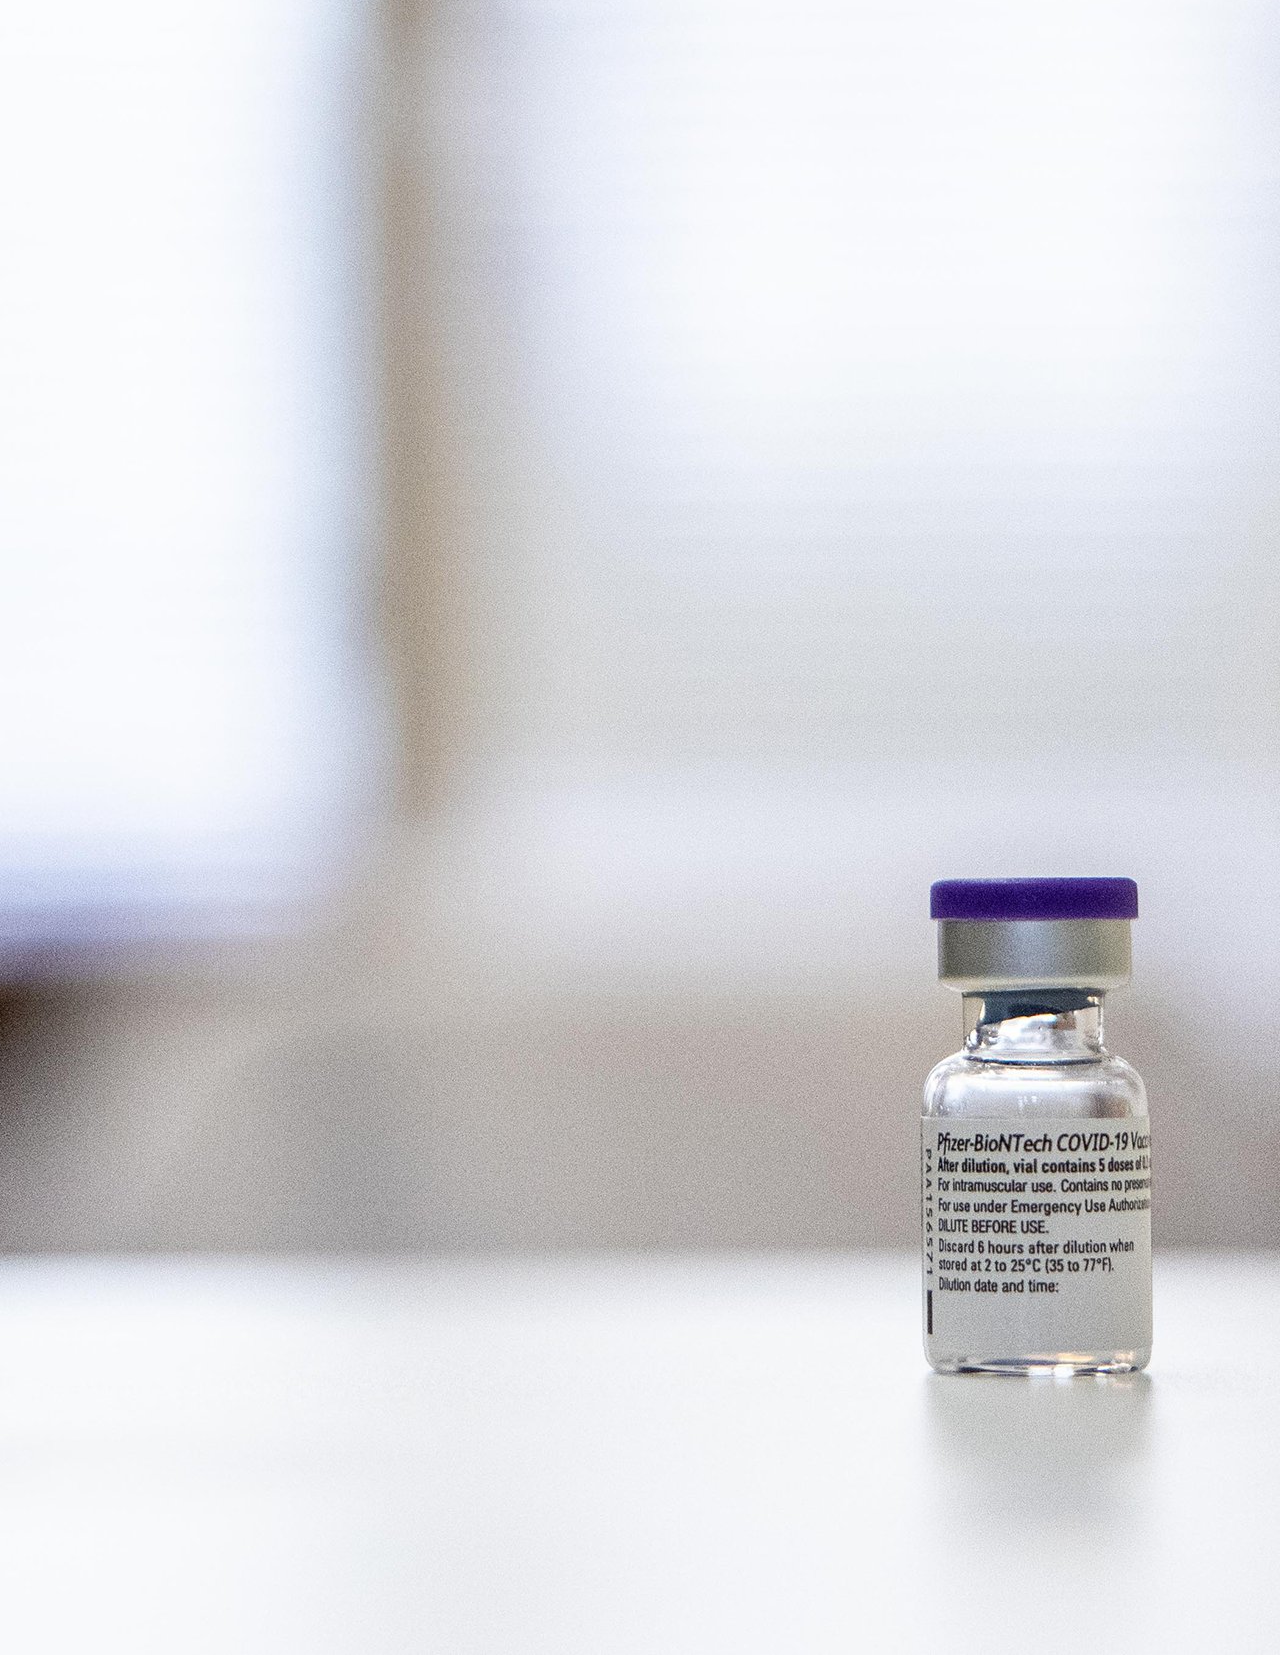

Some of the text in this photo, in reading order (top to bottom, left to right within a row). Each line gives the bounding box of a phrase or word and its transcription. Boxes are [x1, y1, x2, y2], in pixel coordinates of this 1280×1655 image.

[937, 1132, 1052, 1155] Pfizer-BioNTech
[1057, 1132, 1129, 1152] COVID-19
[938, 1157, 959, 1172] After
[961, 1159, 1010, 1174] dilution,
[1014, 1159, 1037, 1173] vial
[1042, 1159, 1096, 1174] contains
[1099, 1158, 1105, 1172] 5
[1107, 1156, 1134, 1172] doses
[938, 1178, 949, 1191] For
[953, 1178, 1027, 1193] intramuscular
[1031, 1181, 1056, 1193] use.
[1061, 1178, 1108, 1192] Contains
[1111, 1180, 1122, 1191] no
[938, 1198, 951, 1212] For
[953, 1201, 970, 1213] use
[974, 1198, 1007, 1213] under
[1011, 1200, 1081, 1216] Emergency
[1085, 1199, 1105, 1213] Use
[938, 1219, 1049, 1234] DILUTE BEFORE USE.
[938, 1238, 1134, 1255] Discard 6 hours after dilution when
[938, 1257, 1114, 1274] stored at 2 to 25°C (35 to 77°F).
[938, 1277, 1059, 1293] Dilution date and time:
